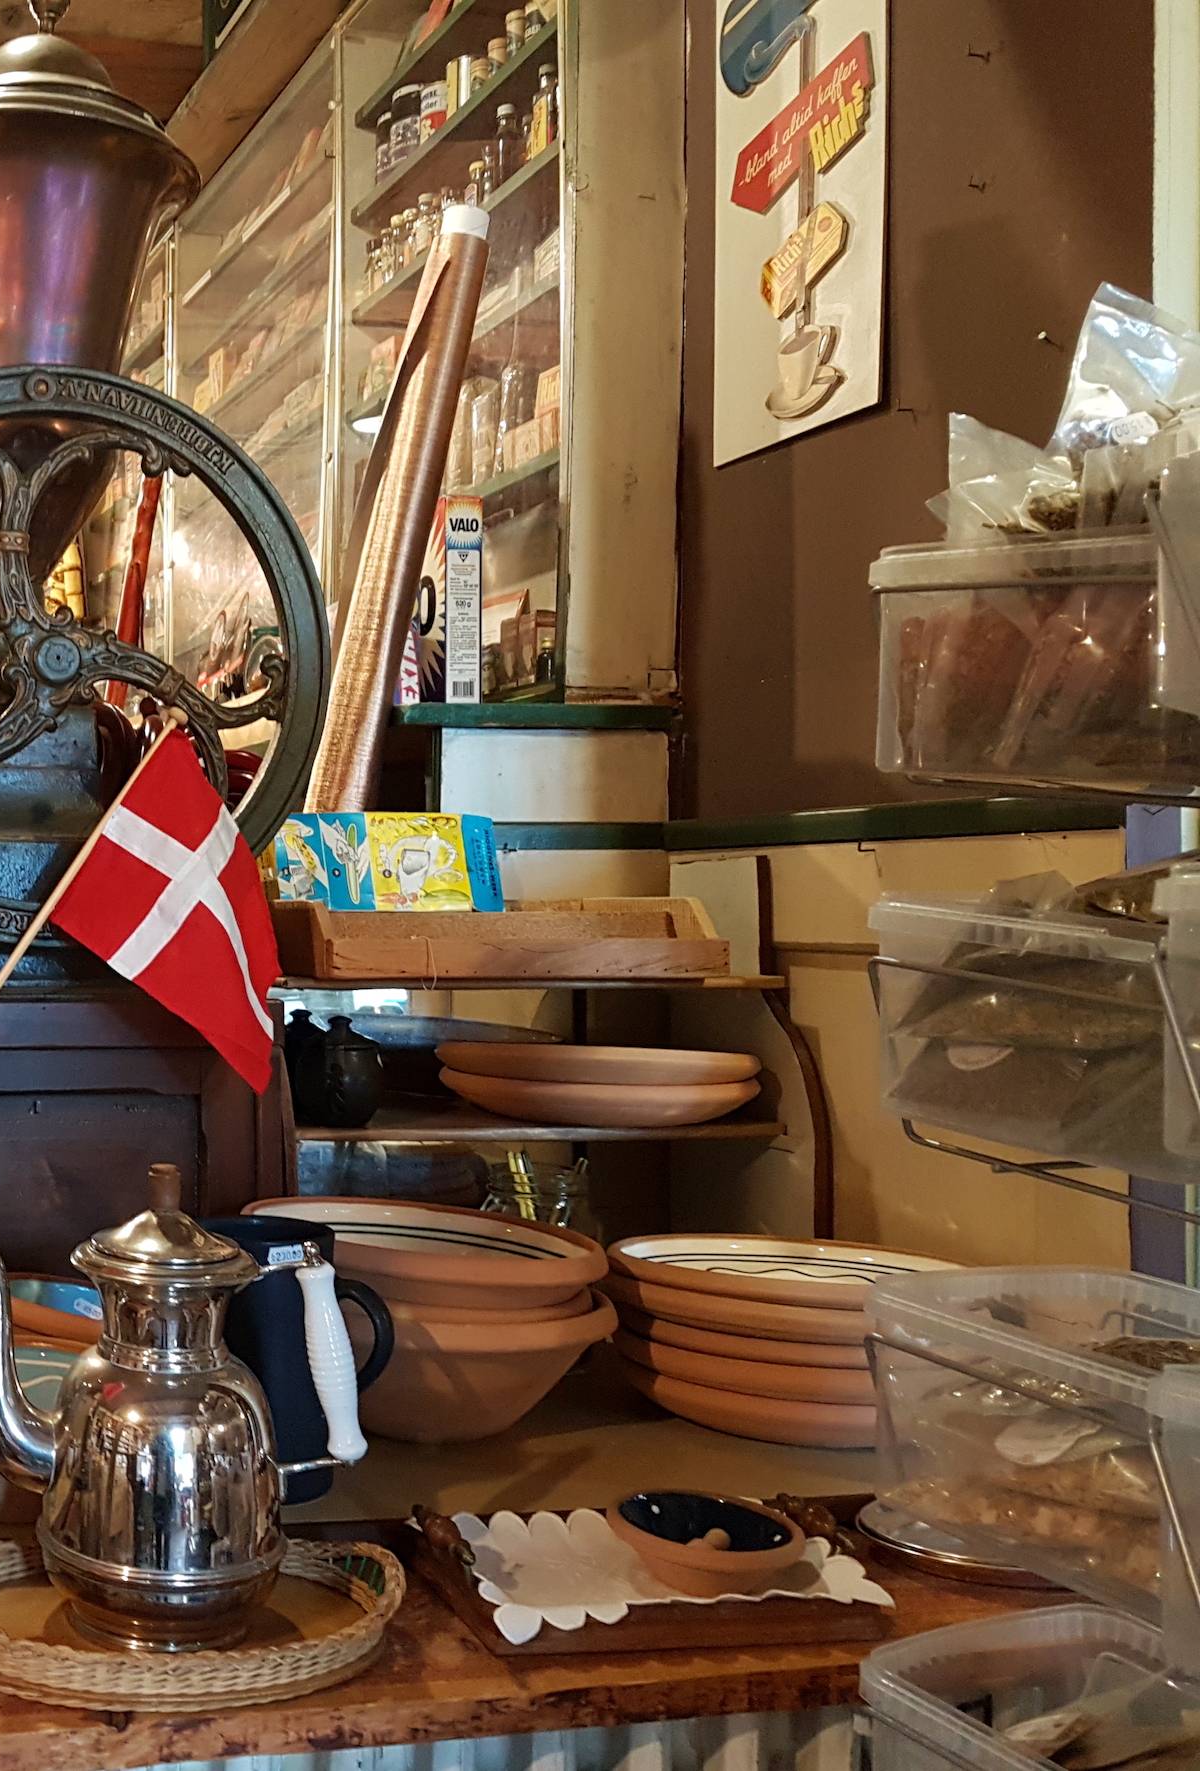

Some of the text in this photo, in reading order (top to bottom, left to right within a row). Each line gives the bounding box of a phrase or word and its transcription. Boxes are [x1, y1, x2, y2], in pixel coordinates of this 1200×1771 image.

[782, 95, 813, 145] altid
[816, 57, 858, 110] kaffen
[767, 143, 793, 187] med
[449, 517, 480, 532] VALO
